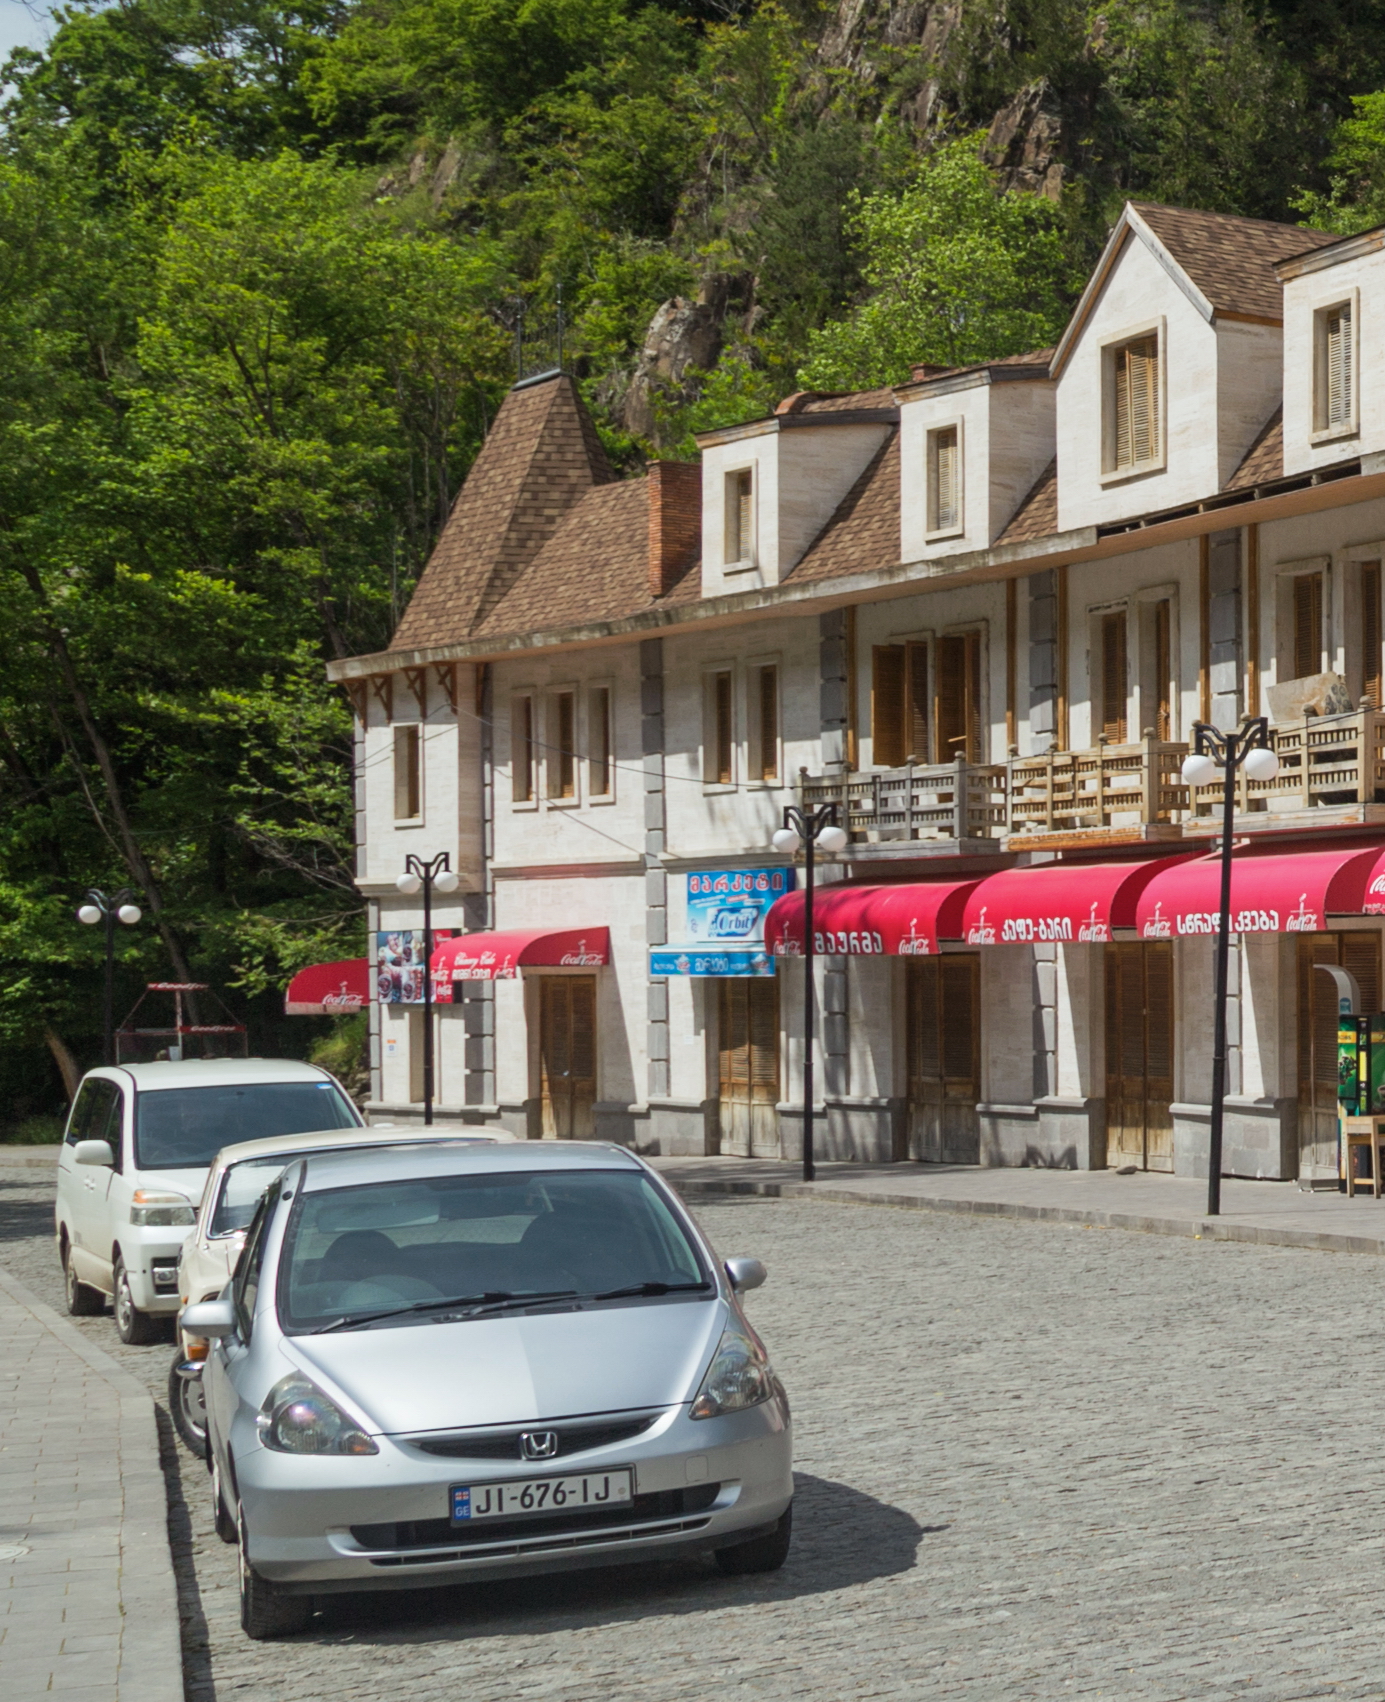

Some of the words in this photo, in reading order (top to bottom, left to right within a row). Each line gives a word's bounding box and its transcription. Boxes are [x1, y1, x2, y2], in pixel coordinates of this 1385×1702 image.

[690, 872, 783, 894] მარკეტი
[719, 914, 751, 930] Orbit
[1001, 916, 1073, 941] კაფე-ბარი
[1234, 910, 1279, 932] კვება
[475, 1476, 610, 1515] JI-676-IJ
[455, 1505, 470, 1517] GE
